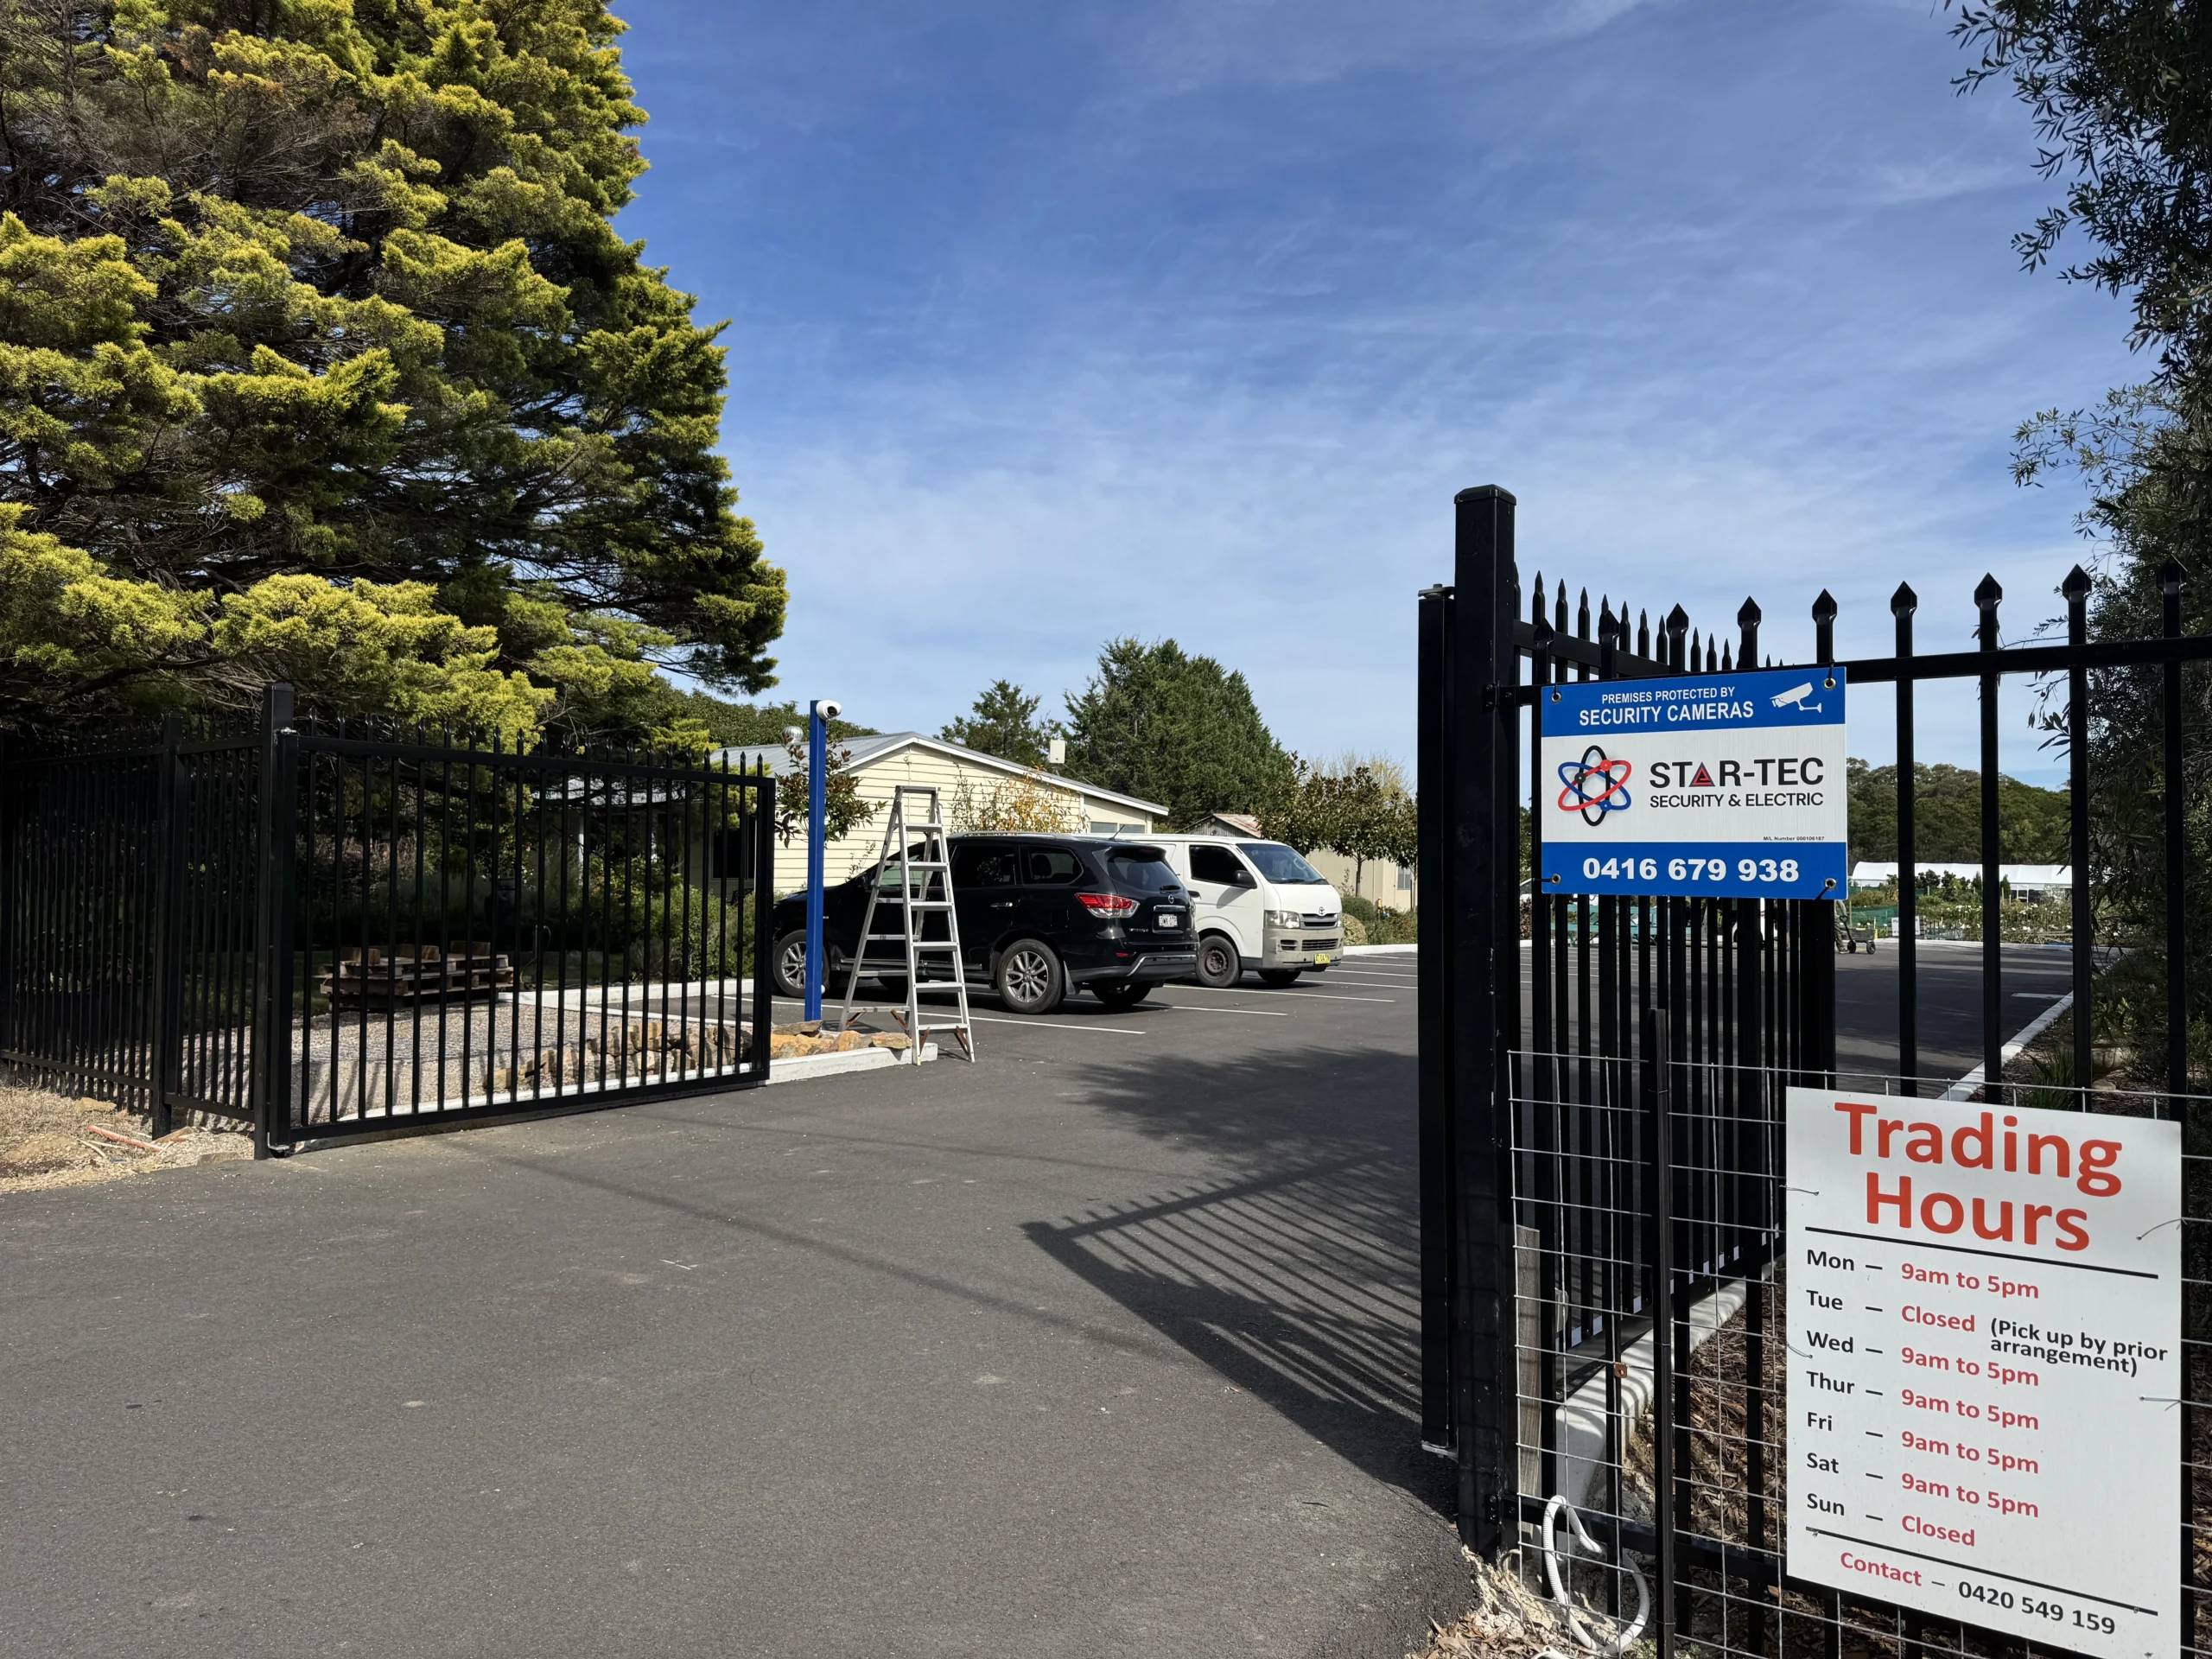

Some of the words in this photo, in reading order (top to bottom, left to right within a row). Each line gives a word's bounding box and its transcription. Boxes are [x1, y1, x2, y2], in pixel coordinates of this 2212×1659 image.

[1579, 705, 1662, 727] SECURITY
[1667, 701, 1754, 721] CAMERAS
[1601, 691, 1653, 704] PREMISES
[1655, 687, 1718, 702] PROTECTED
[1720, 686, 1735, 697] BY
[1649, 793, 1725, 809] SECURITY
[1727, 793, 1742, 807] &
[1745, 791, 1824, 807] ELECTRIC
[1582, 857, 1657, 880] 0416
[1668, 858, 1726, 881] 679
[1738, 859, 1799, 882] 938
[1834, 1102, 2123, 1198] Trading
[1866, 1172, 2090, 1252] Hours
[1807, 1249, 1854, 1272] Mon
[1901, 1262, 1949, 1286] 9am
[1955, 1272, 1980, 1290] to
[1987, 1274, 2039, 1300] 5pm
[1805, 1289, 1843, 1311] Tue
[1901, 1305, 1975, 1332] Closed
[1806, 1330, 1853, 1354] Wed
[1901, 1347, 1949, 1371] 9am
[1955, 1357, 1980, 1376] to
[1987, 1361, 2039, 1387] 5pm
[1990, 1339, 2138, 1378] arrangement)
[1991, 1317, 2041, 1341] (Pick
[2046, 1331, 2074, 1350] up
[2081, 1332, 2107, 1355] by
[2113, 1341, 2168, 1362] prior
[1806, 1370, 1855, 1395] Thur
[1901, 1389, 1949, 1414] 9am
[1955, 1400, 1980, 1419] to
[1987, 1404, 2039, 1431] 5pm
[1807, 1411, 1833, 1432] Fri
[1901, 1431, 1949, 1456] 9am
[1955, 1442, 1980, 1462] to
[1987, 1447, 2038, 1474] 5pm
[1807, 1452, 1840, 1474] Sat
[1901, 1472, 1949, 1498] 9am
[1955, 1485, 1980, 1504] to
[1987, 1491, 2038, 1518] 5pm
[1807, 1492, 1845, 1516] Sun
[1902, 1515, 1975, 1548] Closed
[1840, 1552, 1922, 1586] Contact
[1958, 1581, 2014, 1610] 0420
[2021, 1596, 2064, 1622] 549
[2072, 1610, 2115, 1635] 159
